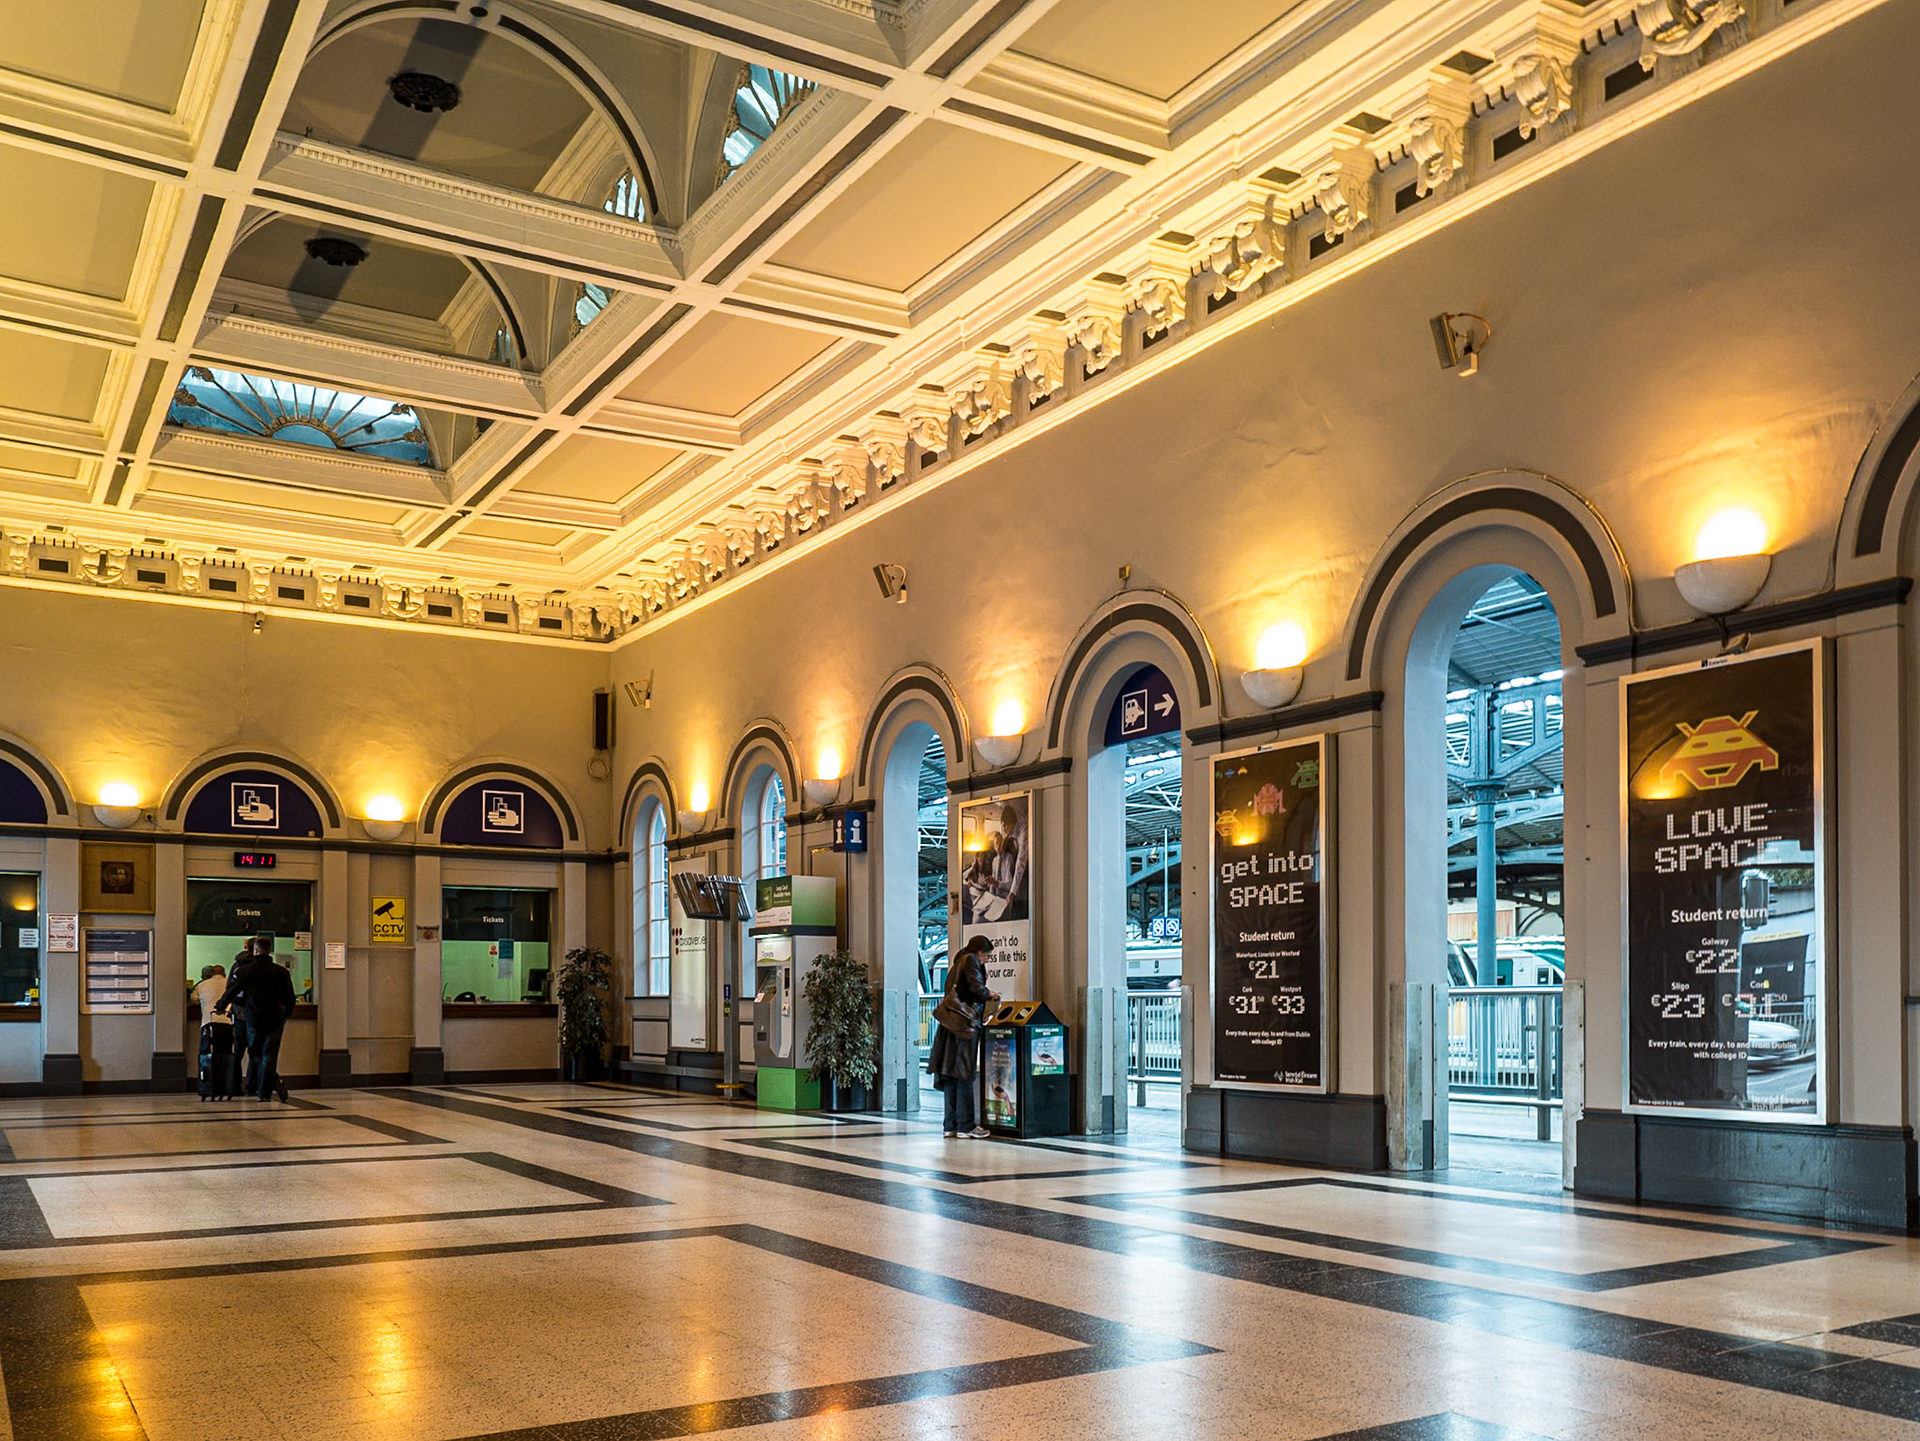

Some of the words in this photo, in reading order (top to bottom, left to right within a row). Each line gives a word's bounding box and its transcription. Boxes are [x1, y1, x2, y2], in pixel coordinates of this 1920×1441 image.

[1666, 802, 1768, 840] LOVE
[1654, 835, 1782, 873] SPACE
[1221, 854, 1260, 884] get
[1268, 850, 1314, 874] into
[1229, 881, 1304, 908] SPACE
[236, 908, 261, 917] Tickets
[1671, 908, 1723, 923] Student
[1725, 907, 1769, 920] return
[482, 916, 504, 924] Tickets
[373, 924, 404, 933] CCTV
[1008, 934, 1019, 947] do
[1239, 931, 1270, 942] Student
[1270, 930, 1295, 941] return
[1701, 937, 1729, 947] Galway
[998, 950, 1011, 963] like
[1012, 950, 1027, 962] this
[1685, 948, 1740, 974] €22
[1002, 968, 1016, 978] car.
[1248, 960, 1280, 979] €21
[1671, 982, 1690, 992] Sligo
[1271, 995, 1305, 1014] €33
[1651, 993, 1705, 1018] €23
[1225, 1029, 1237, 1037] Every
[1648, 1039, 1668, 1049] Every
[1688, 1041, 1709, 1049] every
[1727, 1040, 1735, 1048] to
[1736, 1041, 1750, 1049] and
[1751, 1041, 1770, 1049] from
[1771, 1041, 1797, 1049] Dublin
[1693, 1051, 1710, 1059] with
[1710, 1051, 1737, 1060] college
[1665, 1099, 1672, 1107] by
